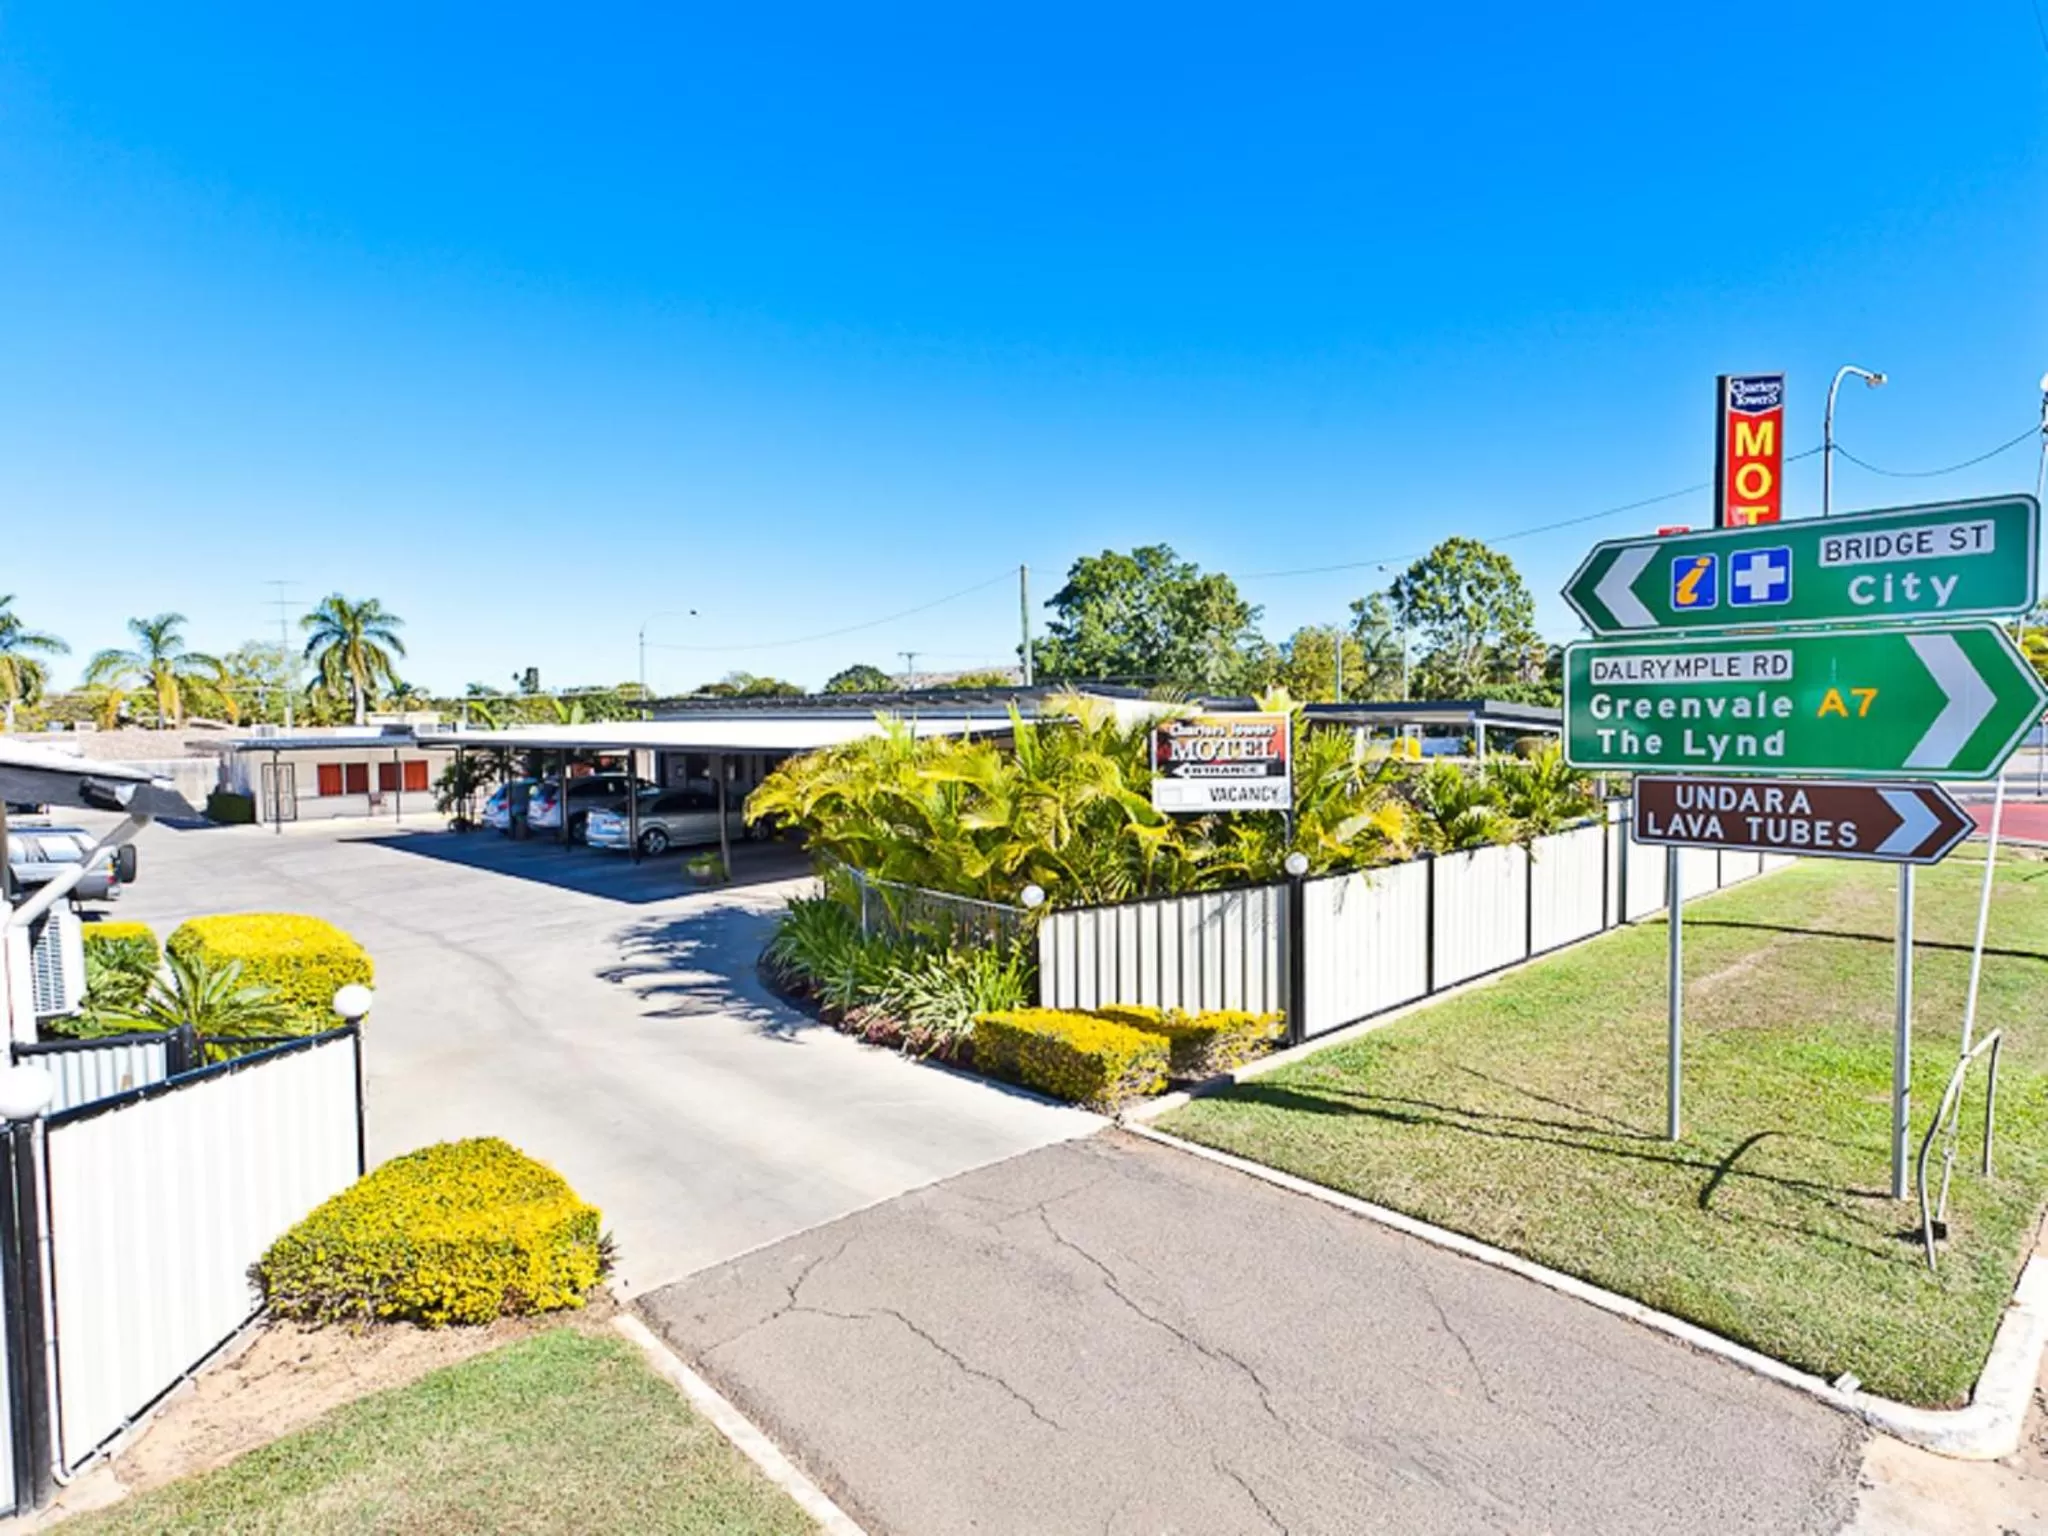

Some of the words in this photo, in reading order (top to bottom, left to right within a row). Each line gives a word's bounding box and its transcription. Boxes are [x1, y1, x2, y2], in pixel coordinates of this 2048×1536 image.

[1824, 530, 1935, 564] BRIDGE
[1949, 523, 1990, 551] ST
[1848, 573, 1960, 607] City
[1593, 656, 1742, 681] DALRYMPLE
[1753, 653, 1789, 676] RD
[1590, 692, 1794, 720] Greenvale
[1816, 687, 1879, 719] A7
[1168, 737, 1279, 761] MOTEL
[1597, 729, 1663, 755] The
[1683, 728, 1786, 763] Lynd
[1208, 785, 1280, 804] VACANCY
[1675, 784, 1812, 815] UNDARA
[1647, 812, 1725, 840] LAVA
[1745, 815, 1859, 848] TUBES
